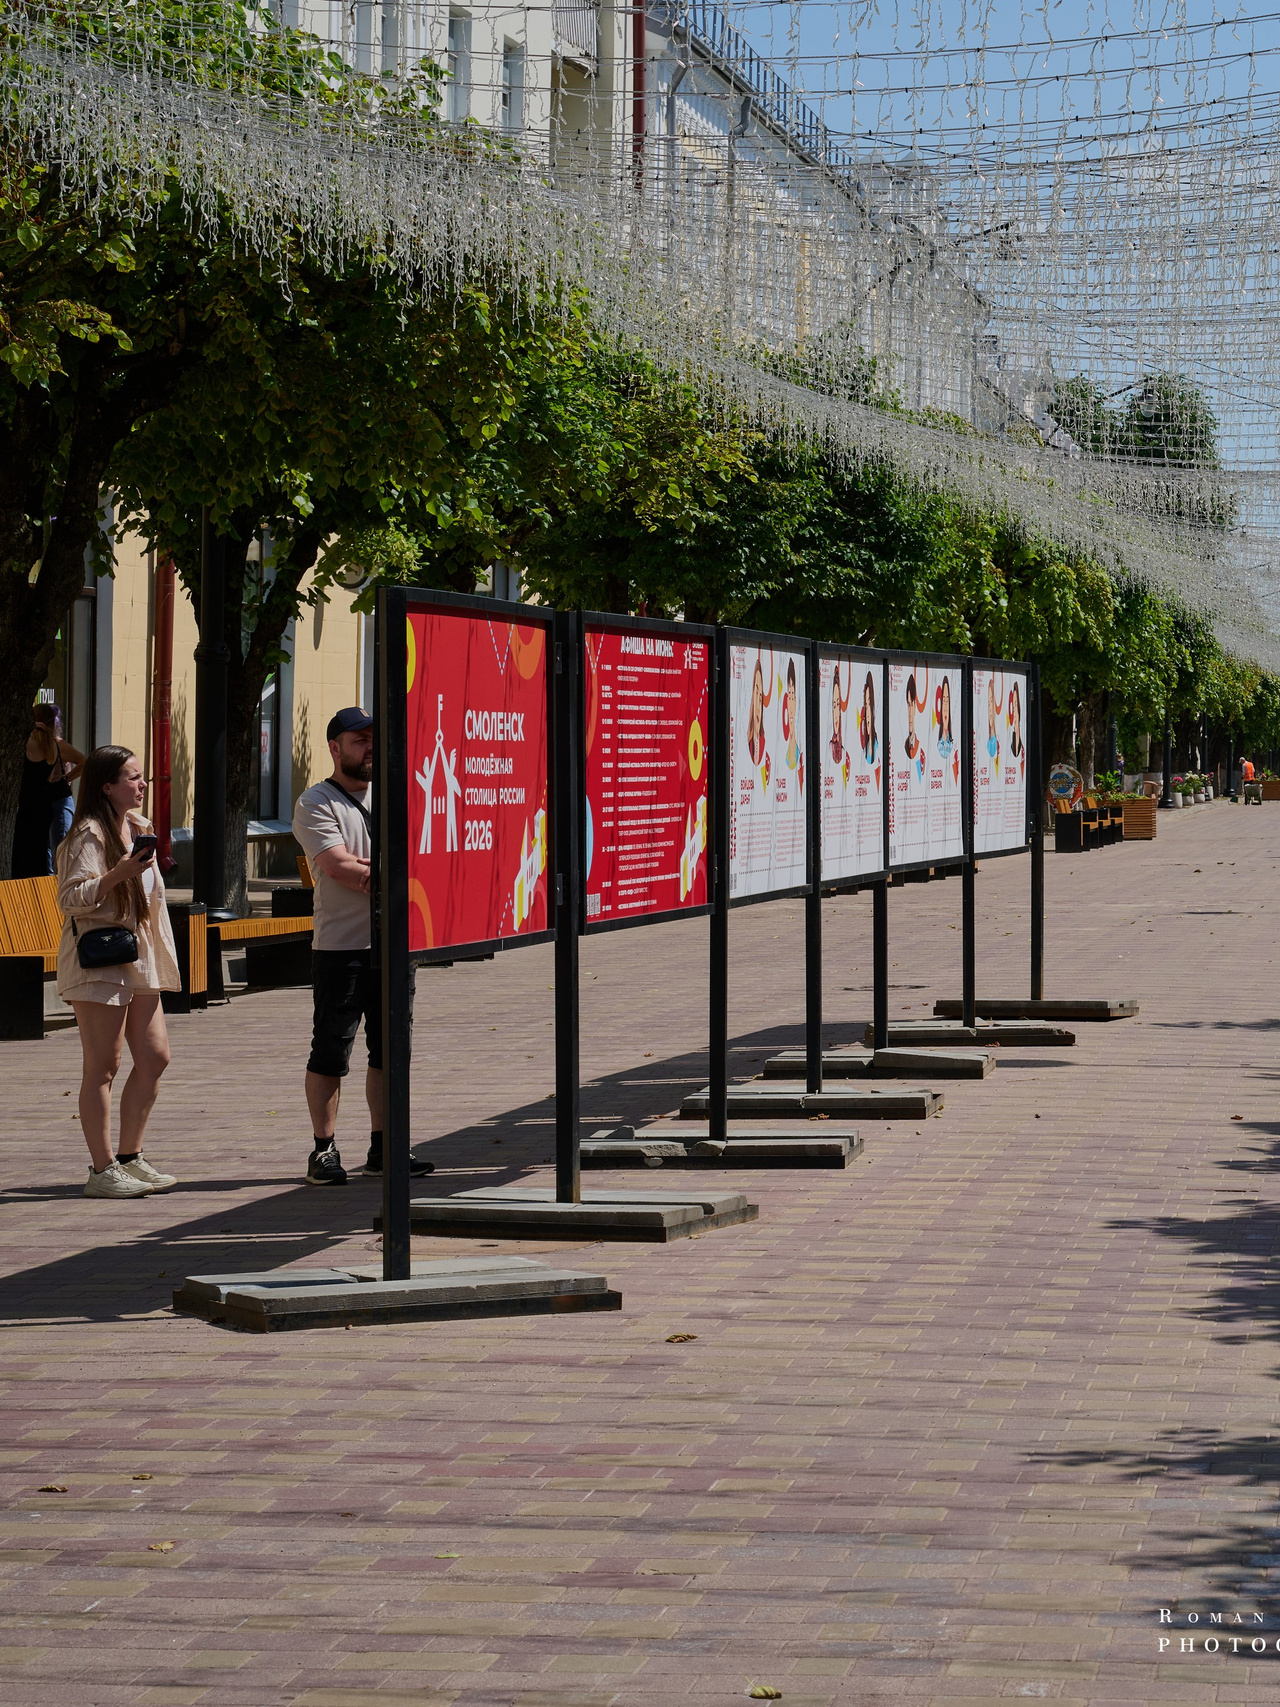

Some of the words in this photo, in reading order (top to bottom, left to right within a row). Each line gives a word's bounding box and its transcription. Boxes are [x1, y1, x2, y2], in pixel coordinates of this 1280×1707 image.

[645, 638, 655, 656] НА
[464, 709, 525, 741] СМОЛЕНСК
[465, 753, 513, 777] МОЛОДЁЖНАЯ
[465, 788, 497, 807] СТОЛИЦА
[499, 787, 526, 805] РОССИИ
[464, 820, 493, 851] 2026
